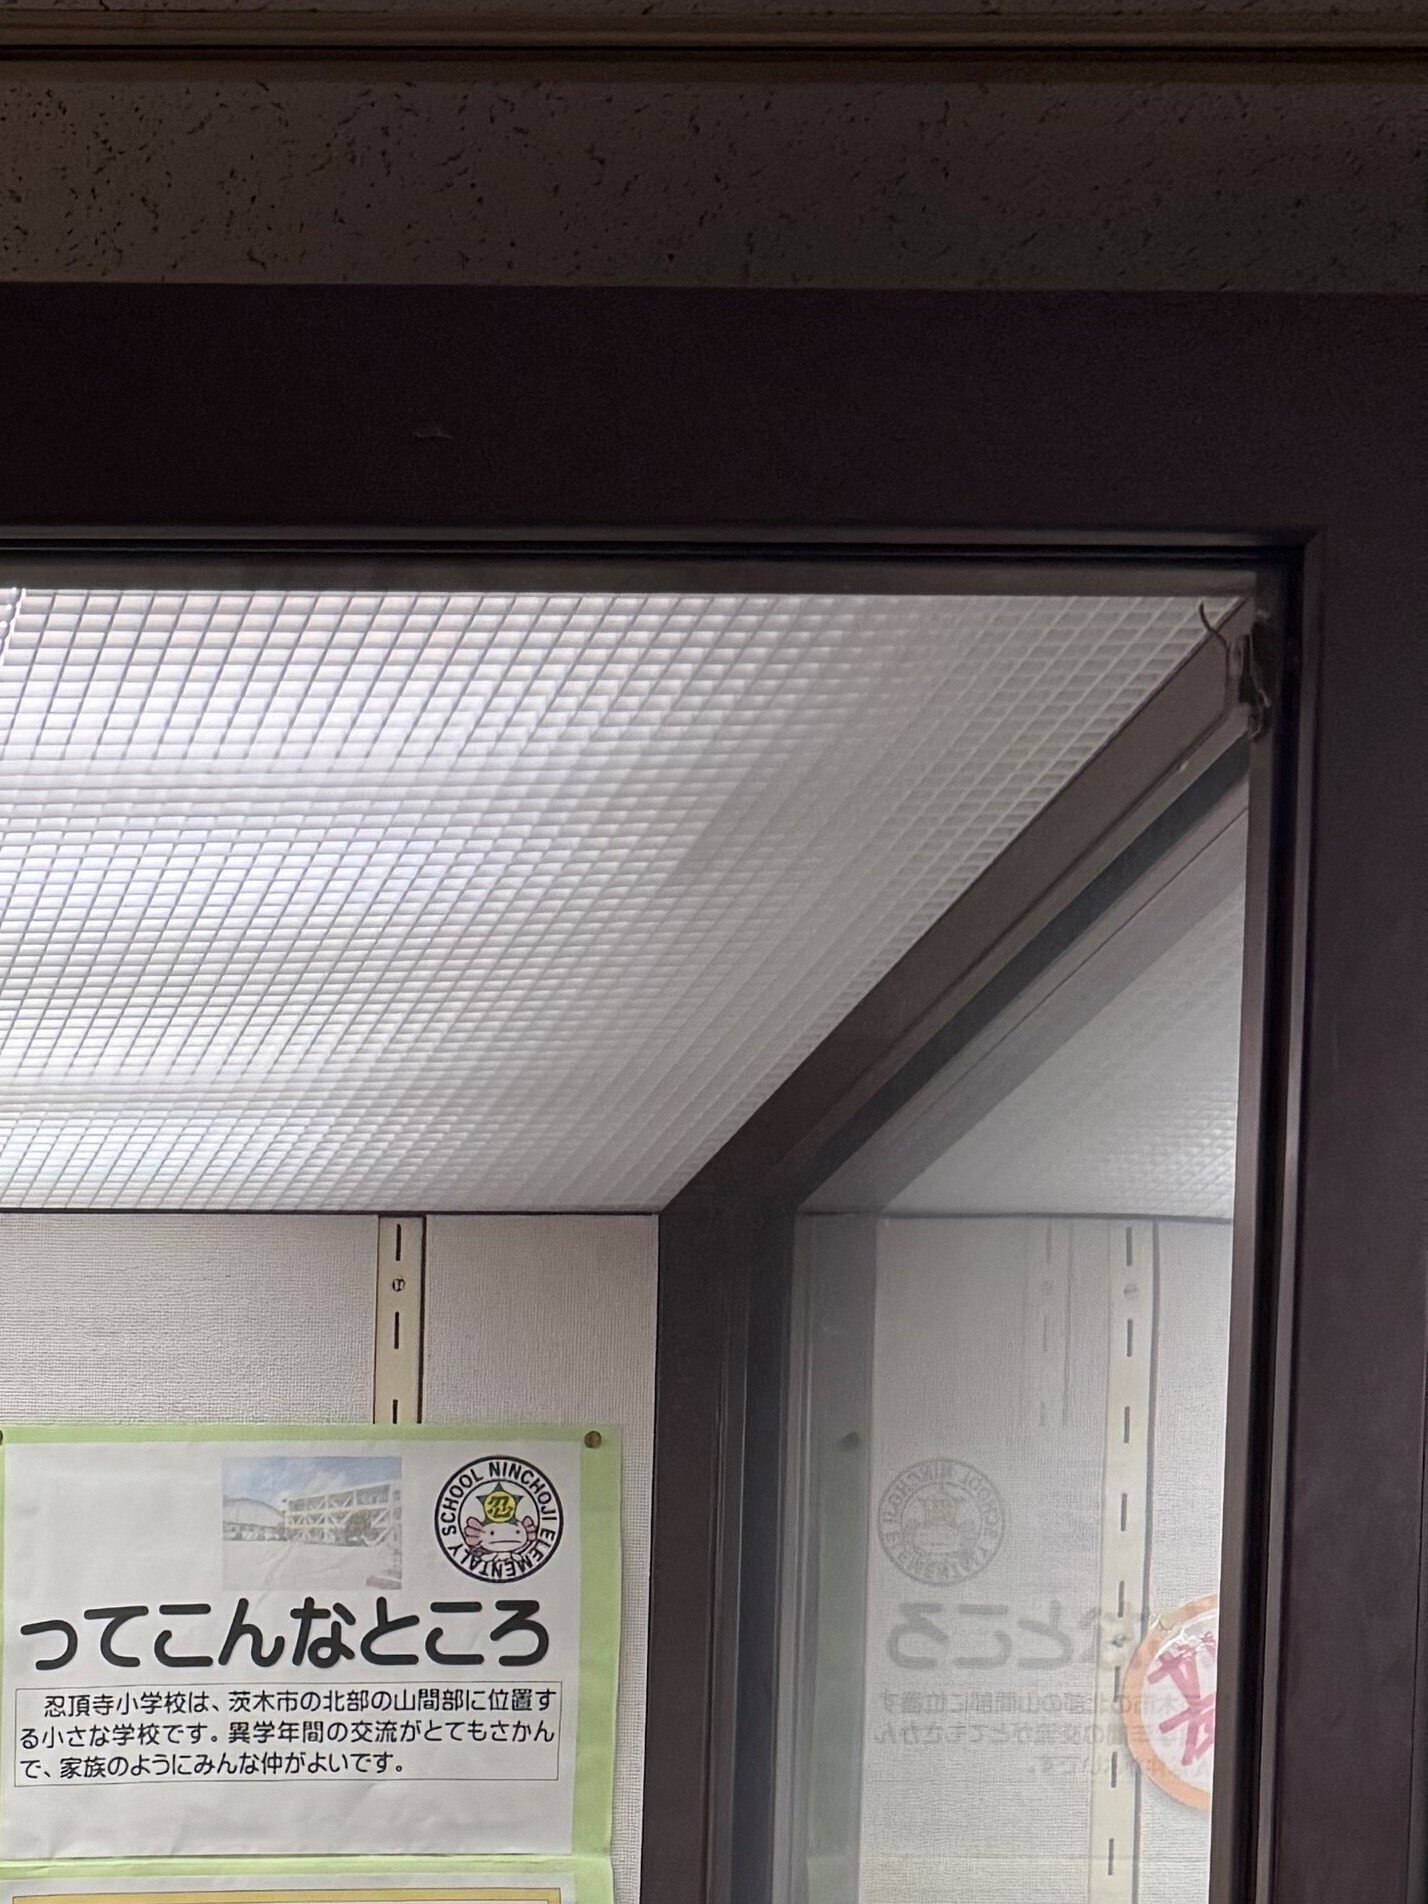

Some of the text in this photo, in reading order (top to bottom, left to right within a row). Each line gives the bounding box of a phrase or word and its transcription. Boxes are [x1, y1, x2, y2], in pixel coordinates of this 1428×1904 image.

[441, 1469, 483, 1537] SCHOOL
[488, 1461, 557, 1521] NINCHOJI
[19, 1596, 551, 1672] ってこんなところ
[44, 1687, 557, 1719] 忍頂寺小学校は、茨木市の北部の山間部に位置す
[19, 1719, 556, 1749] る小さな学校です。異学年間の交流がとてもさかん
[20, 1751, 405, 1780] で、家族のようにみんな仲がよいです。
